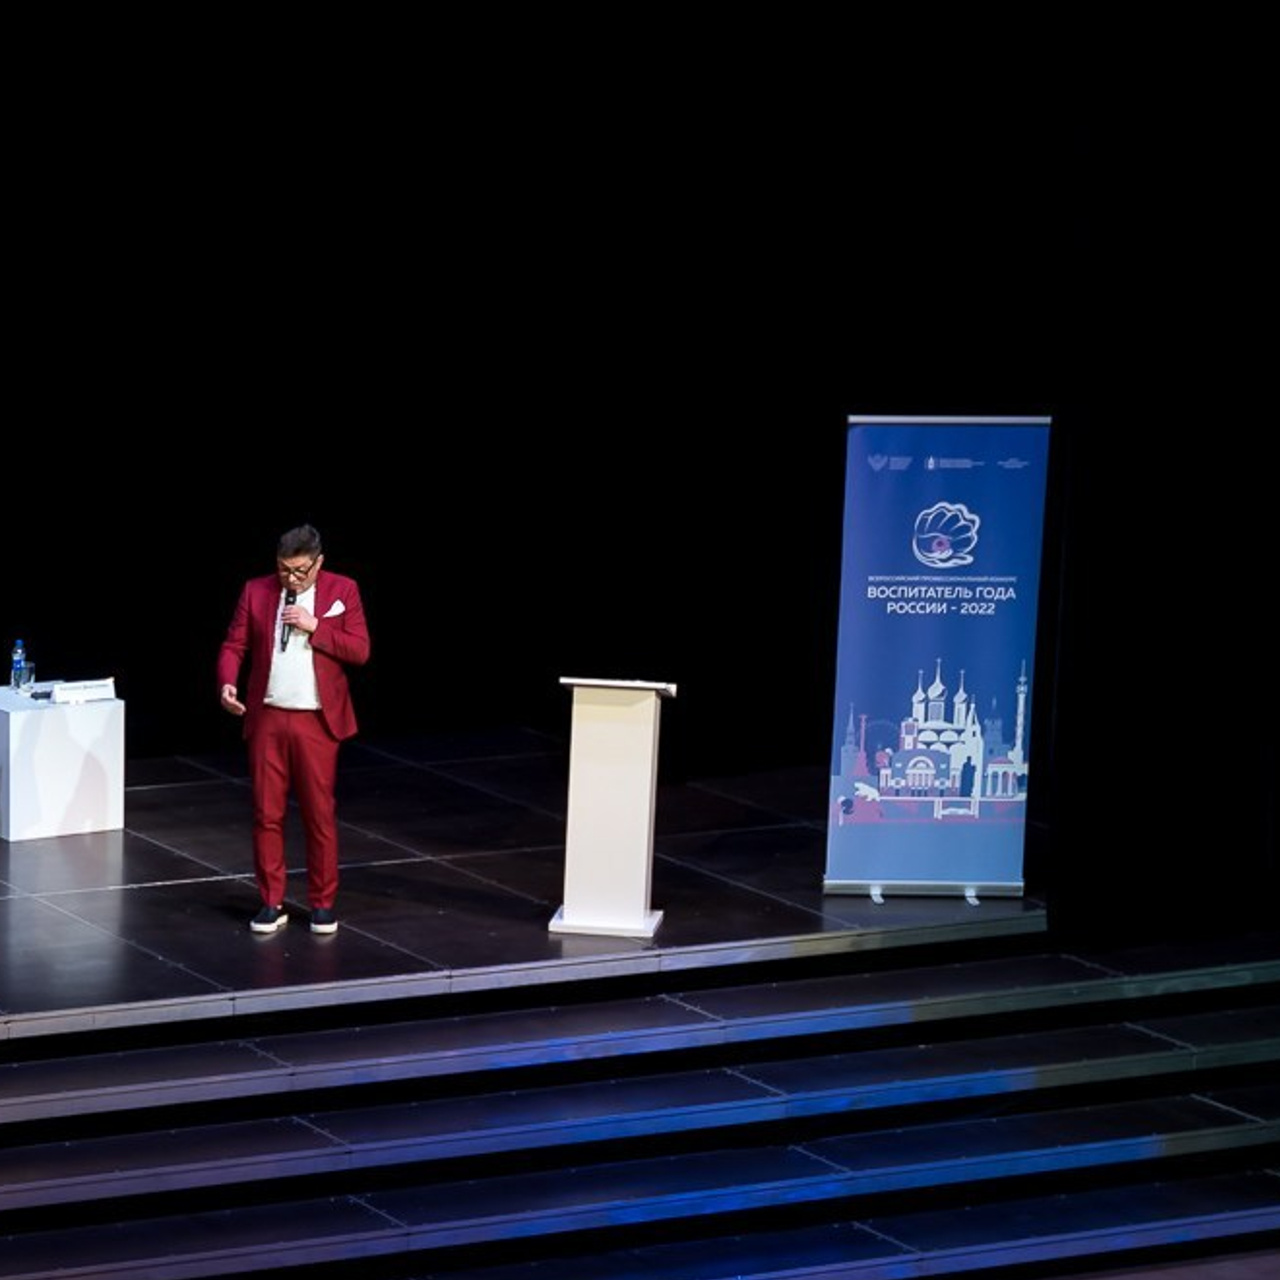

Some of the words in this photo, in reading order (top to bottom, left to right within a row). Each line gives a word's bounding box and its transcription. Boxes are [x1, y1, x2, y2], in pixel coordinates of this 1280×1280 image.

[867, 586, 974, 599] ВОСПИТАТЕЛЬ
[975, 586, 1017, 601] ГОДА
[886, 602, 947, 614] РОССИИ
[960, 602, 996, 615] 2022
